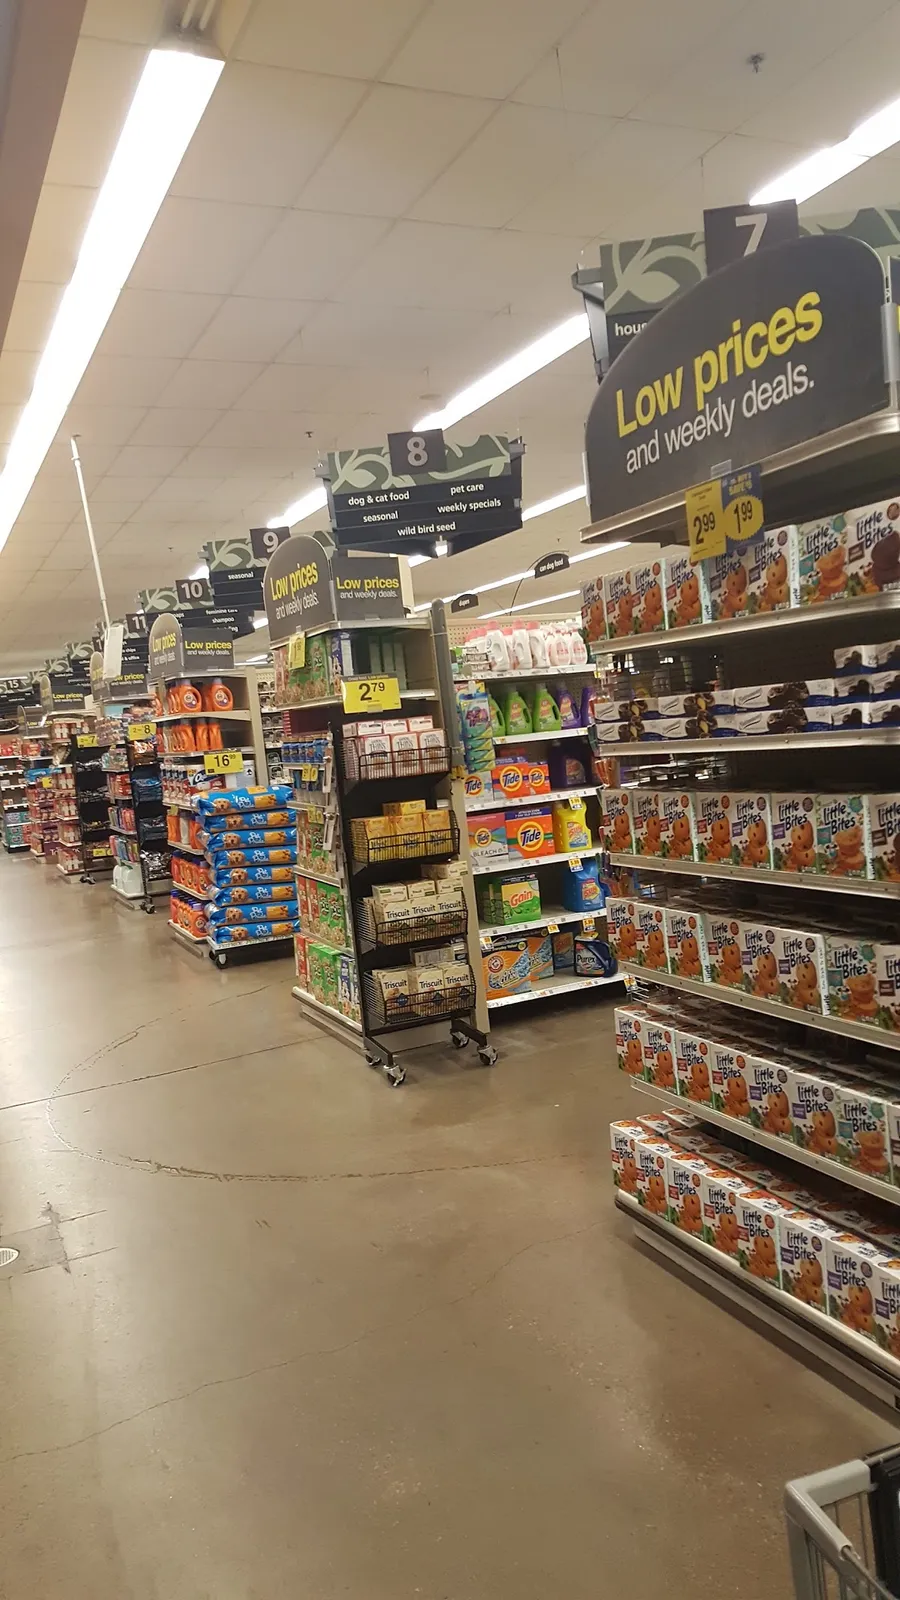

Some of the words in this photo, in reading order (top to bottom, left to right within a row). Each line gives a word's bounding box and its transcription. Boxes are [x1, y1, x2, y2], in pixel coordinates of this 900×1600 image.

[735, 213, 768, 256] 7
[616, 366, 684, 438] Low
[693, 291, 823, 411] prices
[626, 438, 660, 474] and
[664, 397, 736, 454] weekly
[742, 361, 815, 419] deals.
[407, 437, 428, 467] 8
[450, 485, 464, 496] pet
[465, 482, 484, 492] care
[348, 496, 365, 506] dog
[366, 495, 374, 504] &
[375, 494, 389, 503] cat
[390, 491, 410, 502] food
[437, 502, 467, 514] weekly
[468, 498, 501, 511] specials
[363, 511, 398, 523] seasonal
[397, 526, 416, 537] wild
[417, 523, 435, 535] bird
[436, 521, 456, 533] seed
[857, 510, 883, 541] Little
[263, 531, 279, 553] 9
[806, 525, 830, 555] Little
[865, 521, 893, 549] Bites
[755, 537, 774, 566] Little
[814, 538, 838, 562] Bites
[547, 562, 555, 570] dog
[554, 558, 563, 567] food
[760, 549, 783, 571] Bites
[228, 572, 254, 580] seasonal
[671, 559, 687, 581] Little
[270, 577, 289, 601] Low
[290, 562, 319, 598] prices
[336, 577, 361, 590] Low
[364, 576, 399, 592] prices
[677, 569, 694, 588] Bites
[181, 581, 203, 600] 10
[340, 590, 353, 599] and
[354, 590, 377, 600] weekly
[275, 605, 286, 619] and
[286, 599, 303, 616] weekly
[132, 616, 146, 630] 11
[185, 641, 204, 649] Low
[205, 640, 232, 651] prices
[8, 680, 19, 688] 15
[124, 673, 145, 682] prices
[465, 779, 483, 791] Tide
[502, 771, 521, 785] Tide
[530, 772, 543, 783] Tide
[664, 798, 679, 817] Little
[702, 798, 718, 817] Little
[736, 800, 754, 820] Little
[778, 799, 799, 822] Little
[823, 802, 846, 825] Little
[669, 808, 685, 824] Bites
[707, 810, 725, 826] Bites
[742, 812, 761, 828] Bites
[785, 813, 807, 830] Bites
[831, 817, 856, 835] Bites
[476, 833, 490, 842] Tide
[520, 829, 541, 846] Tide
[473, 848, 498, 858] BLEACH
[438, 900, 461, 911] Triscuit
[510, 891, 533, 908] Gain
[386, 908, 410, 919] Triscuit
[412, 903, 436, 914] Triscuit
[611, 905, 626, 921] Little
[616, 917, 632, 928] Bites
[639, 911, 653, 928] Little
[671, 917, 686, 934] Little
[645, 923, 660, 935] Bites
[677, 930, 693, 942] Bites
[712, 923, 728, 940] Little
[718, 936, 735, 949] Bites
[745, 931, 763, 949] Little
[783, 938, 803, 958] Little
[751, 944, 770, 959] Bites
[790, 951, 811, 967] Bites
[834, 948, 857, 969] Little
[576, 955, 595, 966] Purex
[843, 962, 868, 979] Bites
[384, 980, 407, 989] Triscuit
[419, 979, 443, 988] Triscuit
[445, 974, 469, 984] Triscuit
[619, 1020, 633, 1033] Little
[623, 1031, 637, 1041] Bites
[648, 1031, 662, 1045] Little
[653, 1043, 668, 1053] Bites
[681, 1041, 697, 1057] Little
[686, 1055, 704, 1066] Bites
[716, 1053, 734, 1070] Little
[722, 1068, 741, 1080] Bites
[754, 1068, 774, 1084] Little
[761, 1082, 782, 1095] Bites
[797, 1085, 819, 1102] Little
[805, 1100, 829, 1113] Bites
[844, 1103, 867, 1121] Little
[851, 1118, 877, 1132] Bites
[614, 1136, 628, 1150] Little
[619, 1149, 634, 1158] Bites
[640, 1154, 655, 1168] Little
[645, 1166, 660, 1177] Bites
[673, 1171, 690, 1185] Little
[679, 1183, 696, 1195] Bites
[709, 1188, 726, 1204] Little
[714, 1202, 733, 1214] Bites
[742, 1210, 762, 1227] Little
[749, 1224, 770, 1237] Bites
[787, 1231, 808, 1248] Little
[794, 1246, 817, 1261] Bites
[834, 1255, 857, 1273] Little
[842, 1270, 866, 1287] Bites
